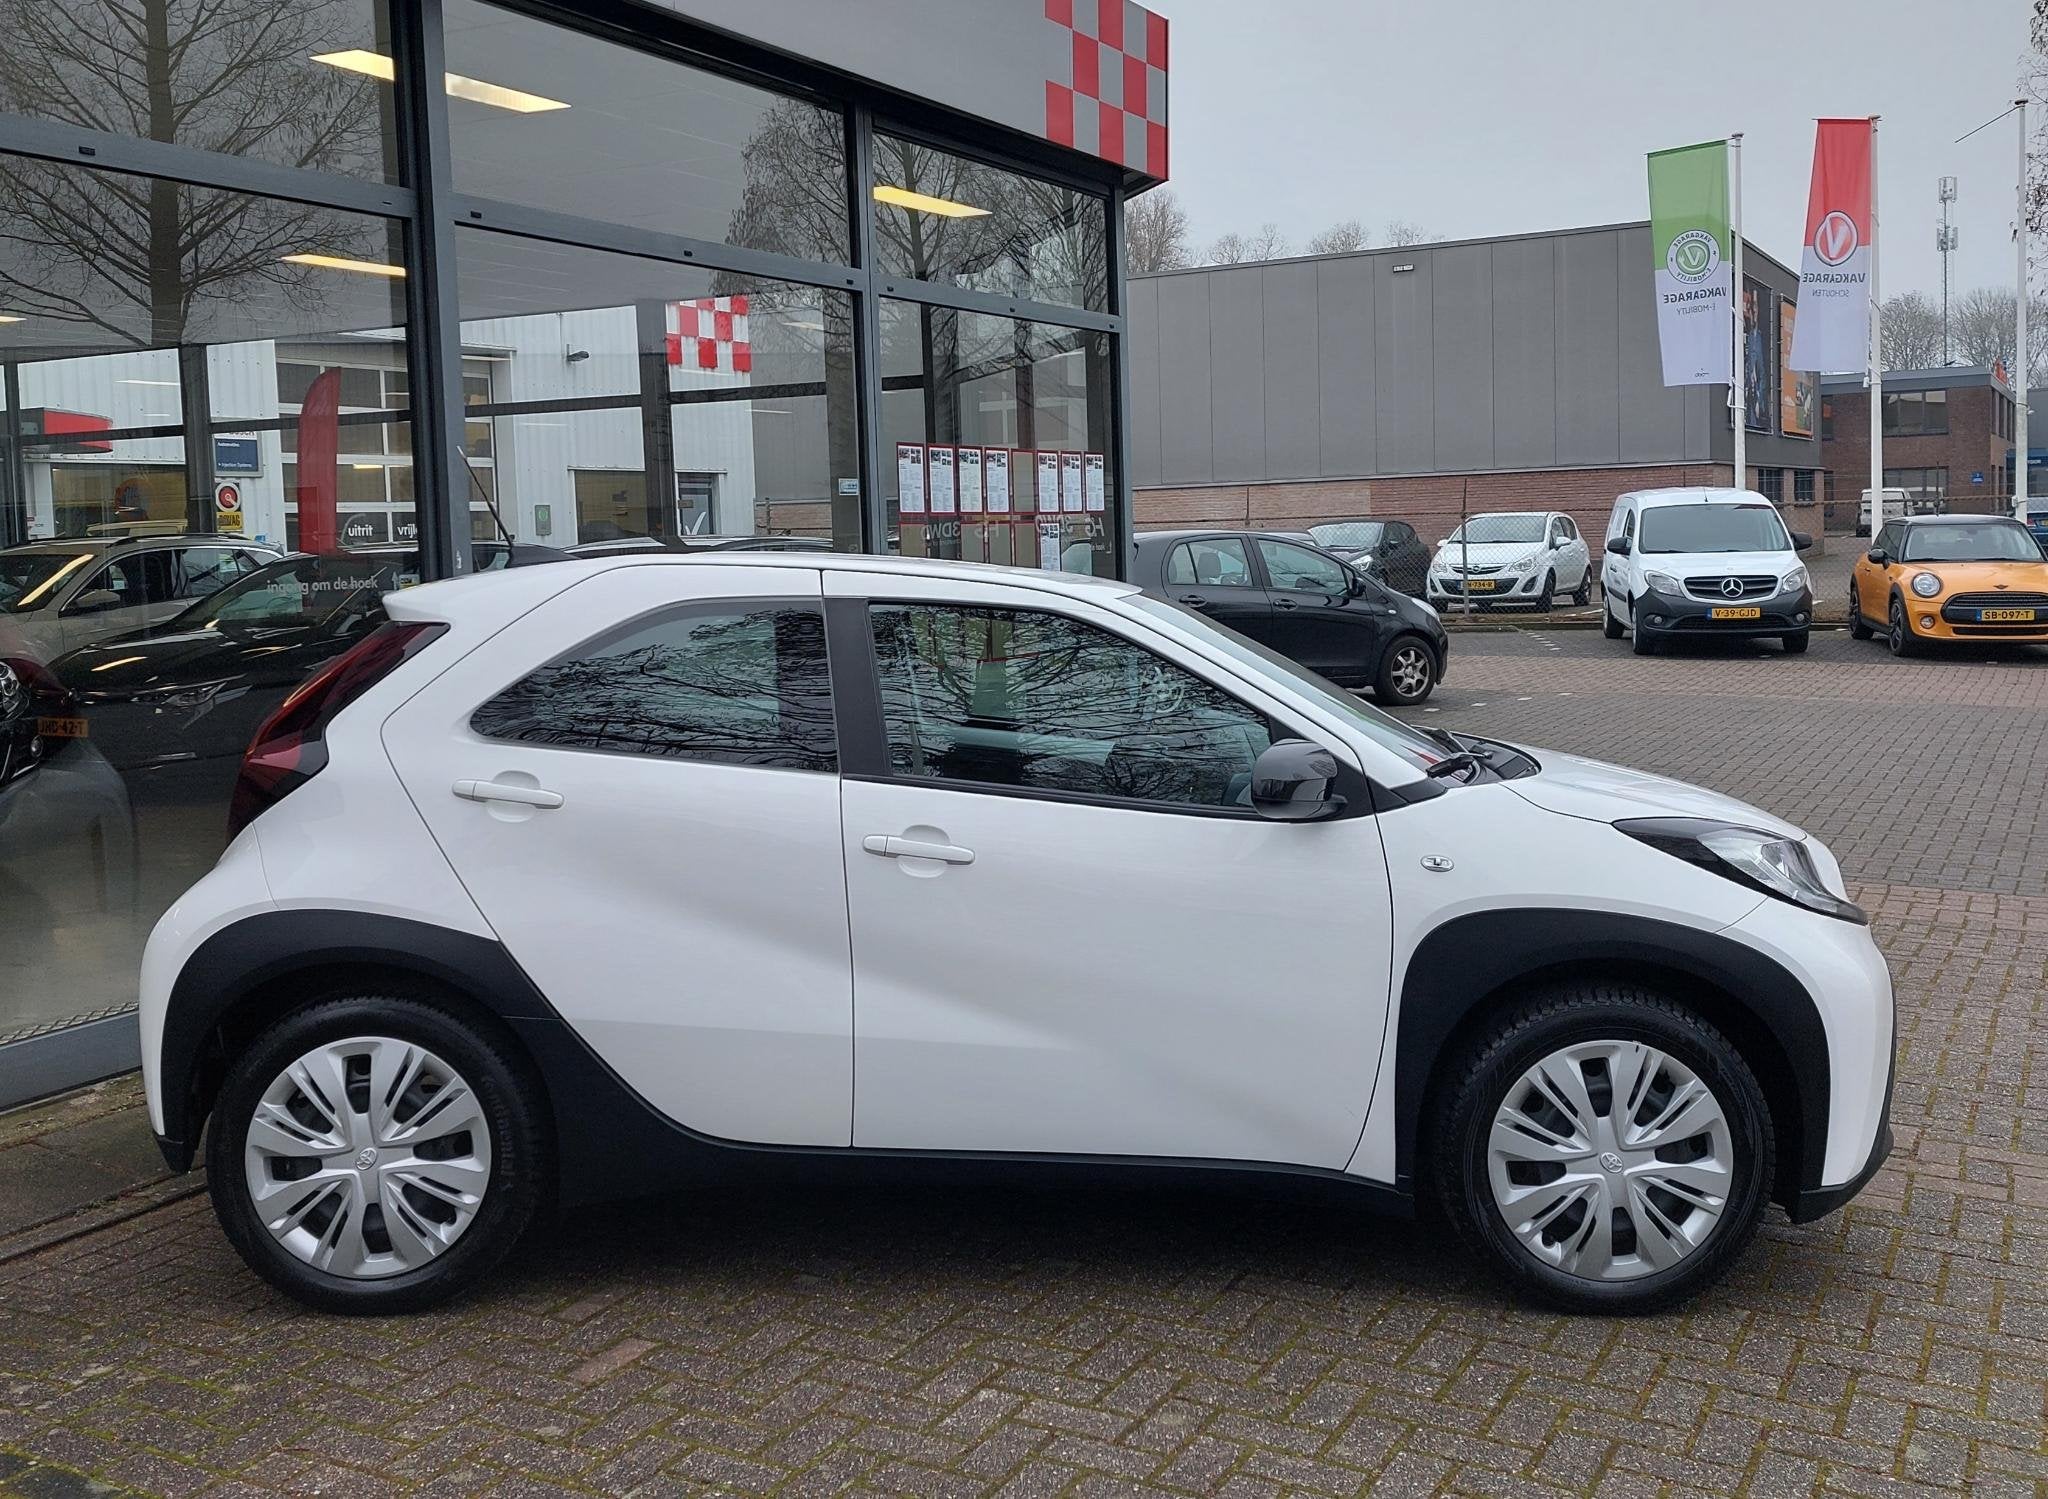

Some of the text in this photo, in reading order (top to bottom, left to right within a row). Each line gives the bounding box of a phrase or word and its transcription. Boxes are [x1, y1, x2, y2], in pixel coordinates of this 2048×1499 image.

[348, 524, 373, 537] uitrit
[312, 580, 331, 591] om
[333, 576, 348, 590] de
[350, 575, 378, 590] hoek
[1715, 609, 1757, 617] V-39-GJD
[1984, 611, 2031, 619] SB-097-T
